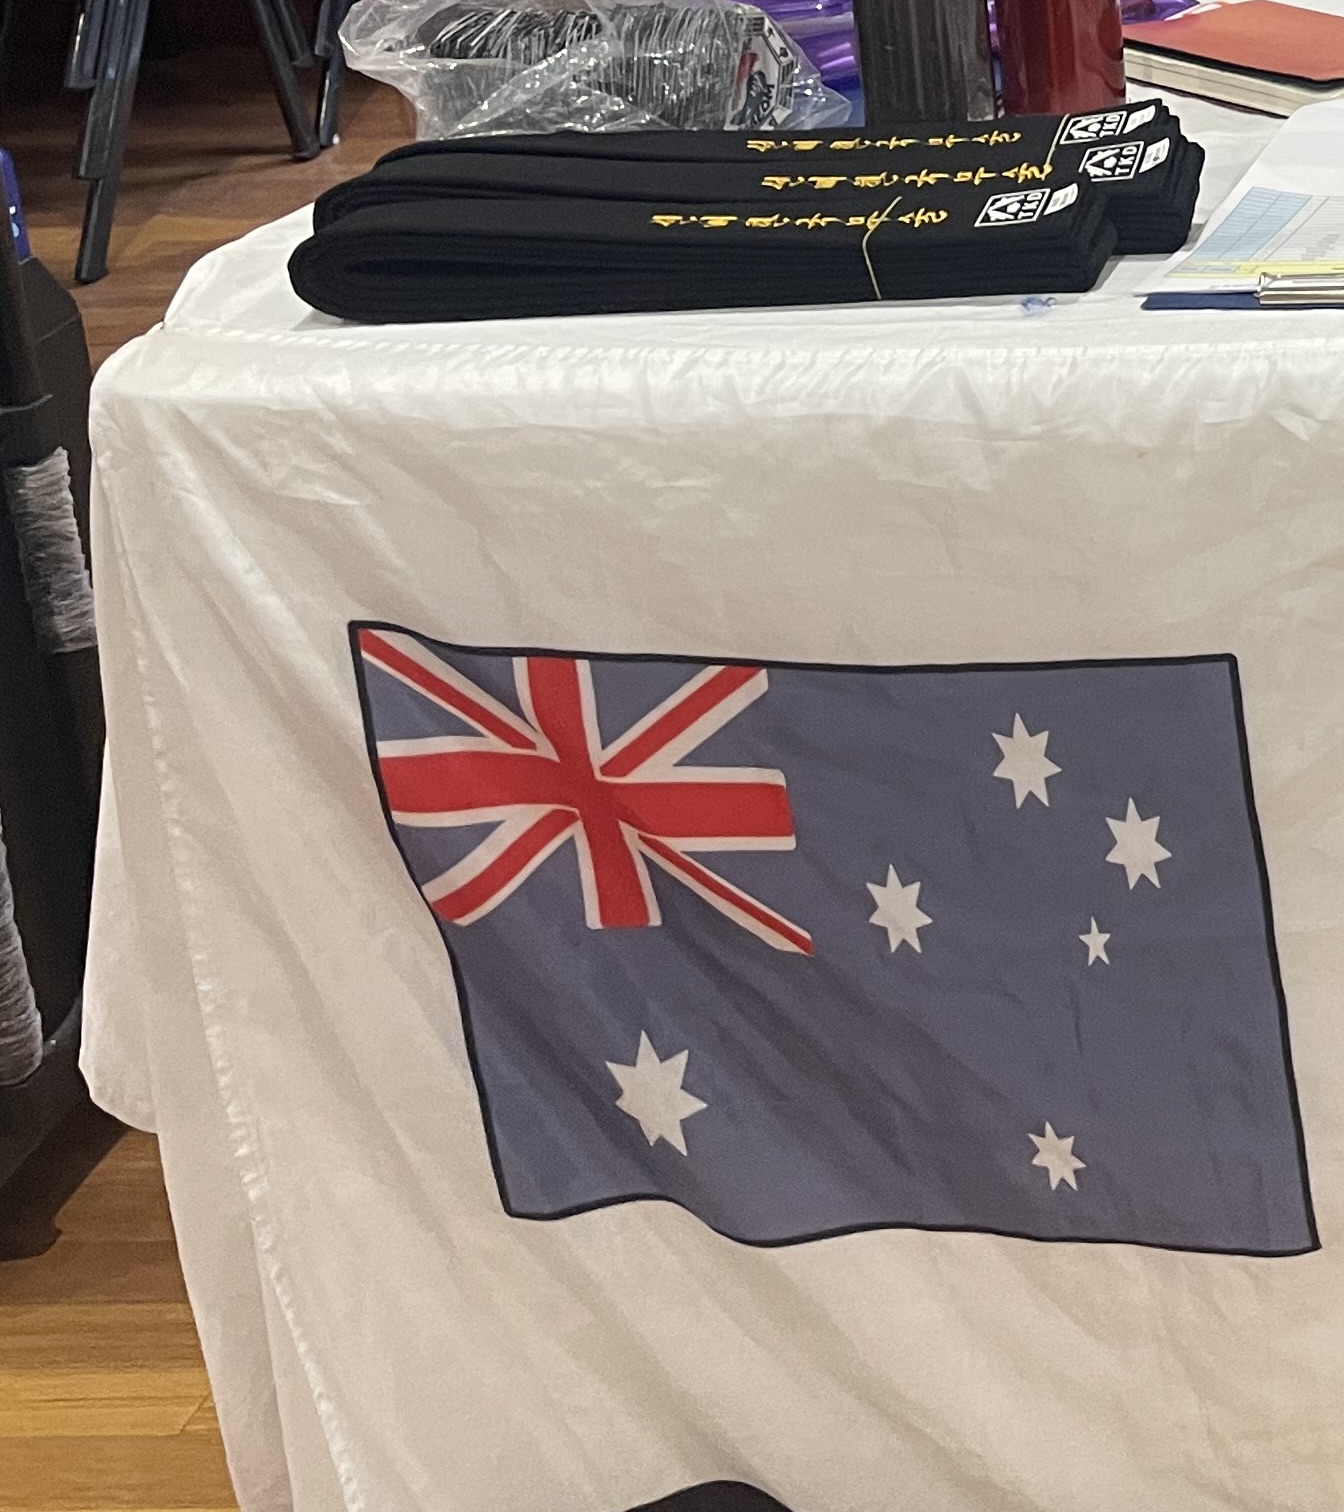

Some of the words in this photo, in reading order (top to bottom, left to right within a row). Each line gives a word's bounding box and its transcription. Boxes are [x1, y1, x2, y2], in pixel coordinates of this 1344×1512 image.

[1100, 113, 1121, 137] TKD
[1115, 146, 1138, 176] TKD
[1018, 192, 1043, 220] TKD
